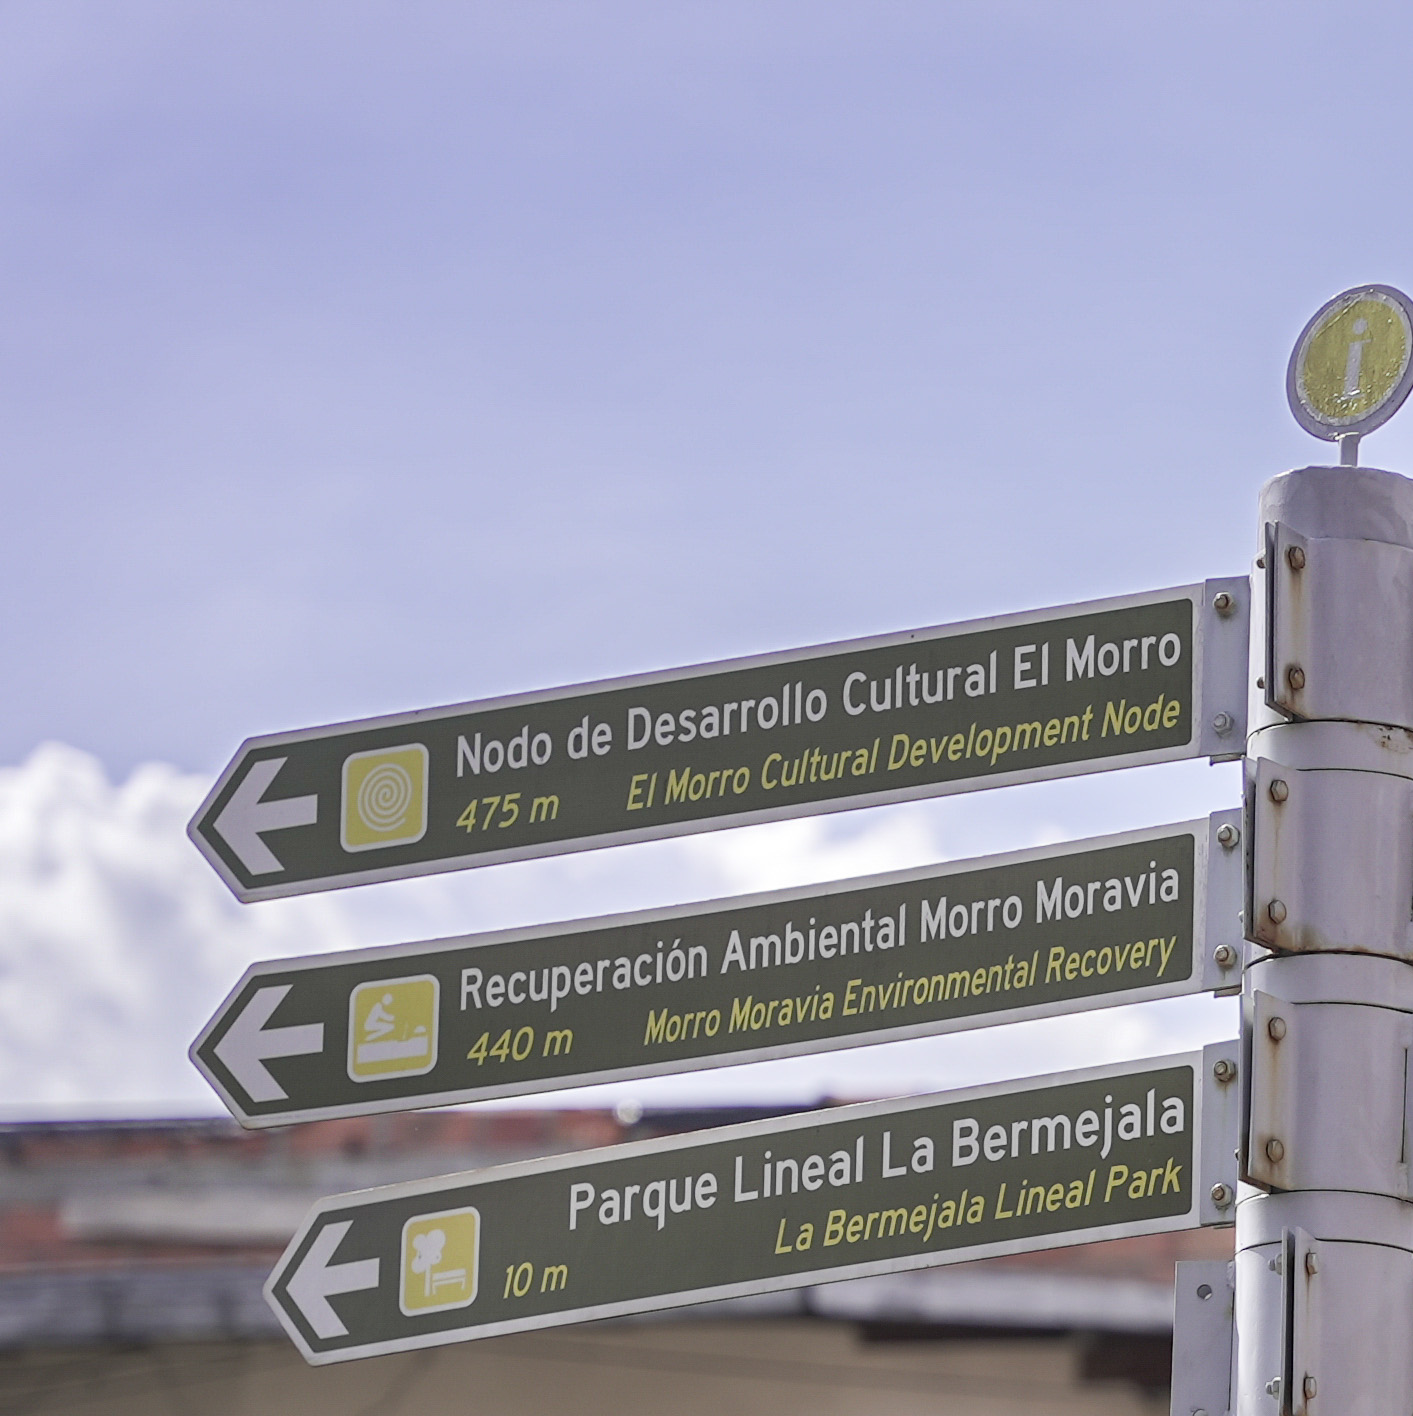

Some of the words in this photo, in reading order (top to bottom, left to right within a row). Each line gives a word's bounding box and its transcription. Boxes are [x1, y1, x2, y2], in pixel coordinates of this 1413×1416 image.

[456, 724, 552, 778] Nodo
[567, 715, 613, 760] de
[627, 681, 828, 751] Desarrollo
[842, 649, 997, 716] Cultural
[1013, 641, 1049, 690] El
[1065, 632, 1181, 682] Morro
[626, 772, 658, 811] El
[664, 766, 750, 805] Morro
[761, 737, 880, 790] Cultural
[887, 704, 1094, 771] Development
[1100, 693, 1180, 738] Node
[455, 792, 521, 833] 475
[529, 794, 560, 823] m
[460, 938, 708, 1013] Recuperación
[719, 902, 907, 974] Ambiental
[920, 895, 1023, 943] Morro
[1036, 860, 1179, 924] Moravia
[643, 1007, 721, 1046] Morro
[728, 991, 835, 1034] Moravia
[842, 949, 1039, 1016] Environmental
[1044, 935, 1177, 984] Recovery
[466, 1026, 534, 1066] 440
[542, 1029, 573, 1057] m
[569, 1172, 718, 1231] Parque
[734, 1135, 865, 1203] Lineal
[881, 1130, 935, 1179] La
[951, 1088, 1185, 1167] Bermejala
[774, 1218, 814, 1255] La
[822, 1188, 985, 1247] Bermejala
[994, 1168, 1097, 1220] Lineal
[1103, 1156, 1183, 1203] Park
[503, 1261, 534, 1299] 10
[540, 1264, 568, 1293] m
